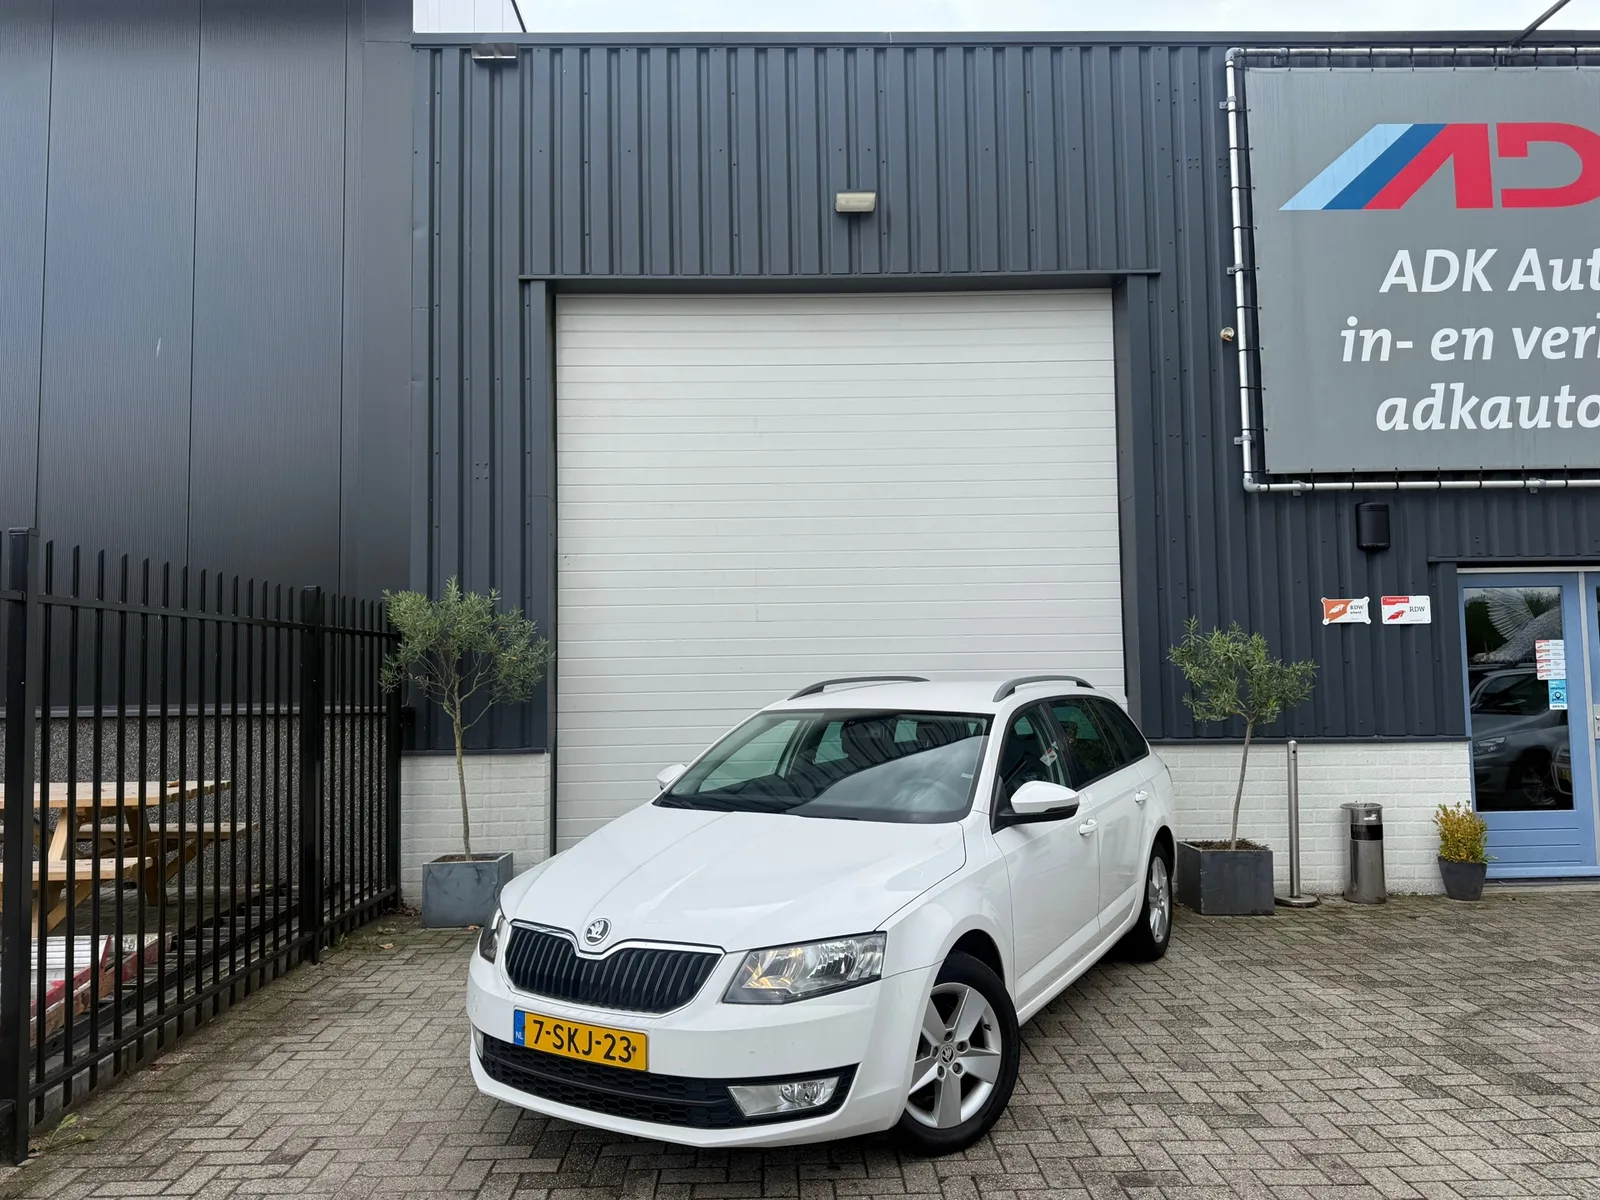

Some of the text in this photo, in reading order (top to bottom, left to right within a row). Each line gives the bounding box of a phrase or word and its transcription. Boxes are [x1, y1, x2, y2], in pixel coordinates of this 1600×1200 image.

[1379, 248, 1498, 293] ADK
[1340, 312, 1600, 362] in- en ver
[1376, 382, 1600, 431] adkauto
[515, 1020, 632, 1062] NL 7-SKJ-23
